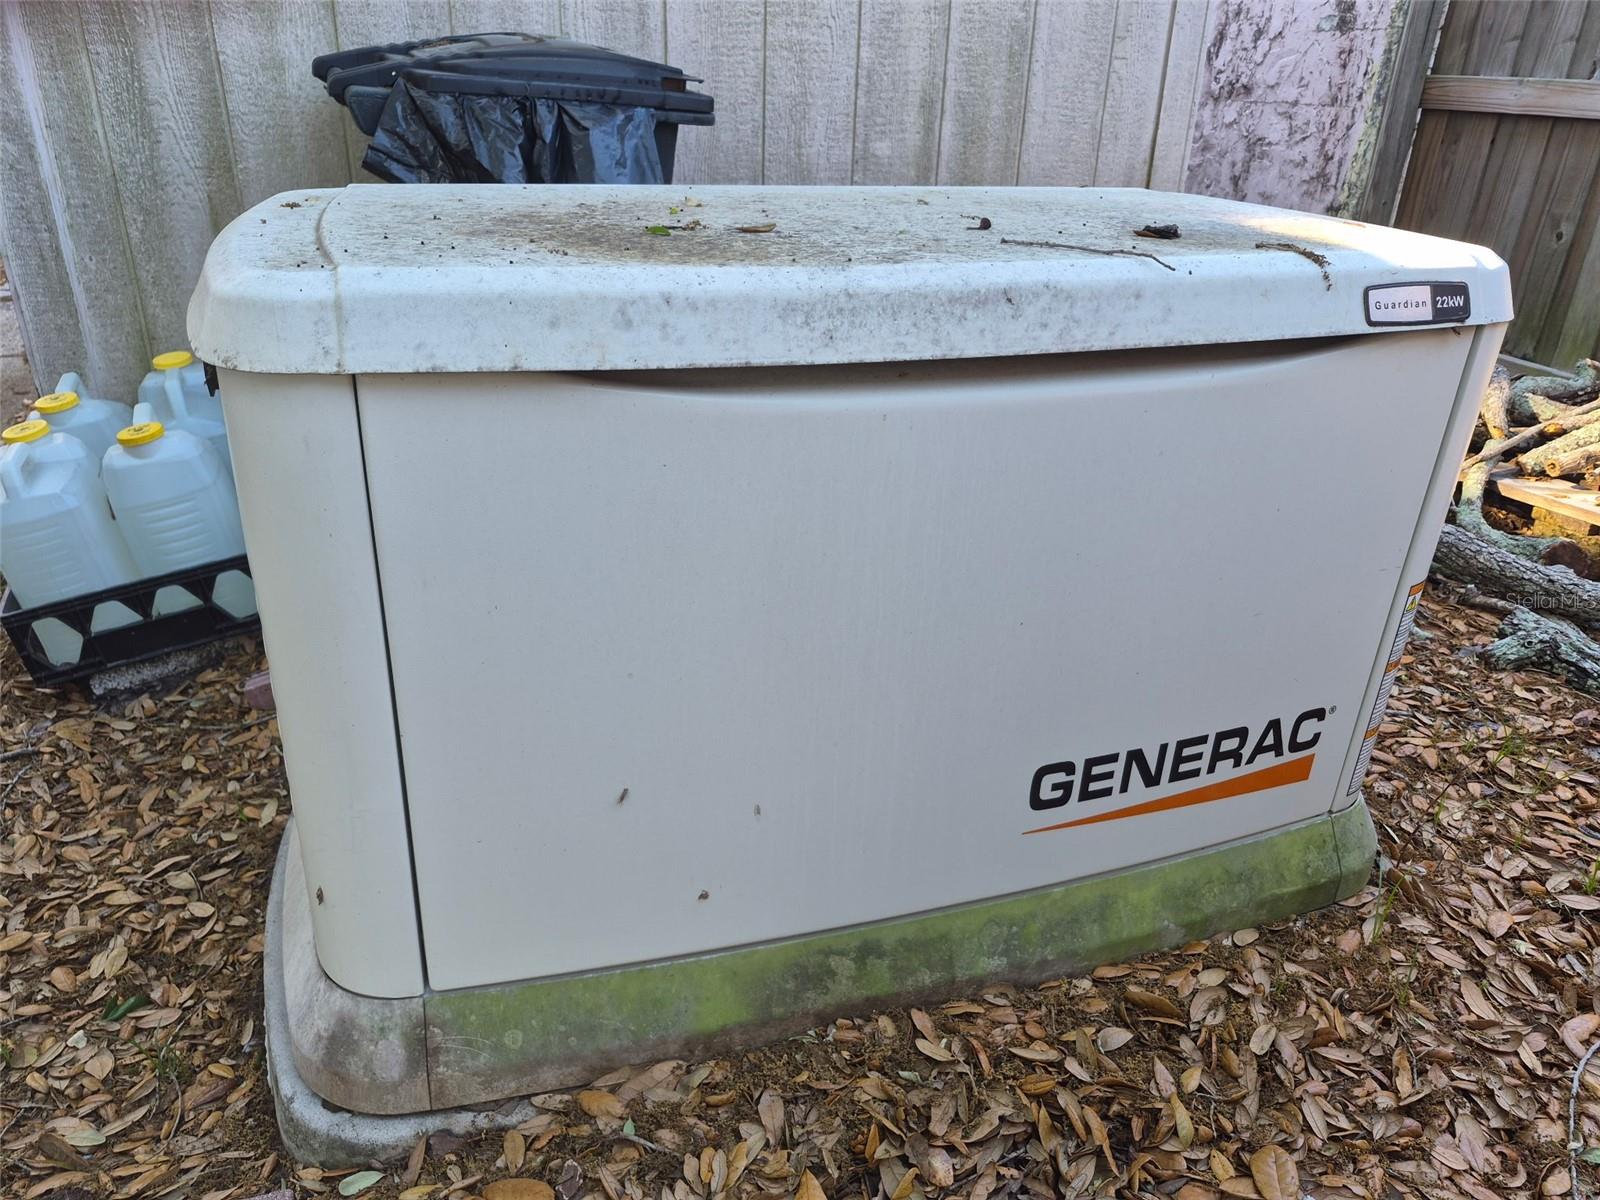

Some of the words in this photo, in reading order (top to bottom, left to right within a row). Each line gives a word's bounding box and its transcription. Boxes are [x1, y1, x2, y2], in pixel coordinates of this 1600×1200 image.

[1375, 299, 1427, 310] Guardian
[1436, 295, 1464, 308] 22kW
[1029, 707, 1327, 811] GENERAC
